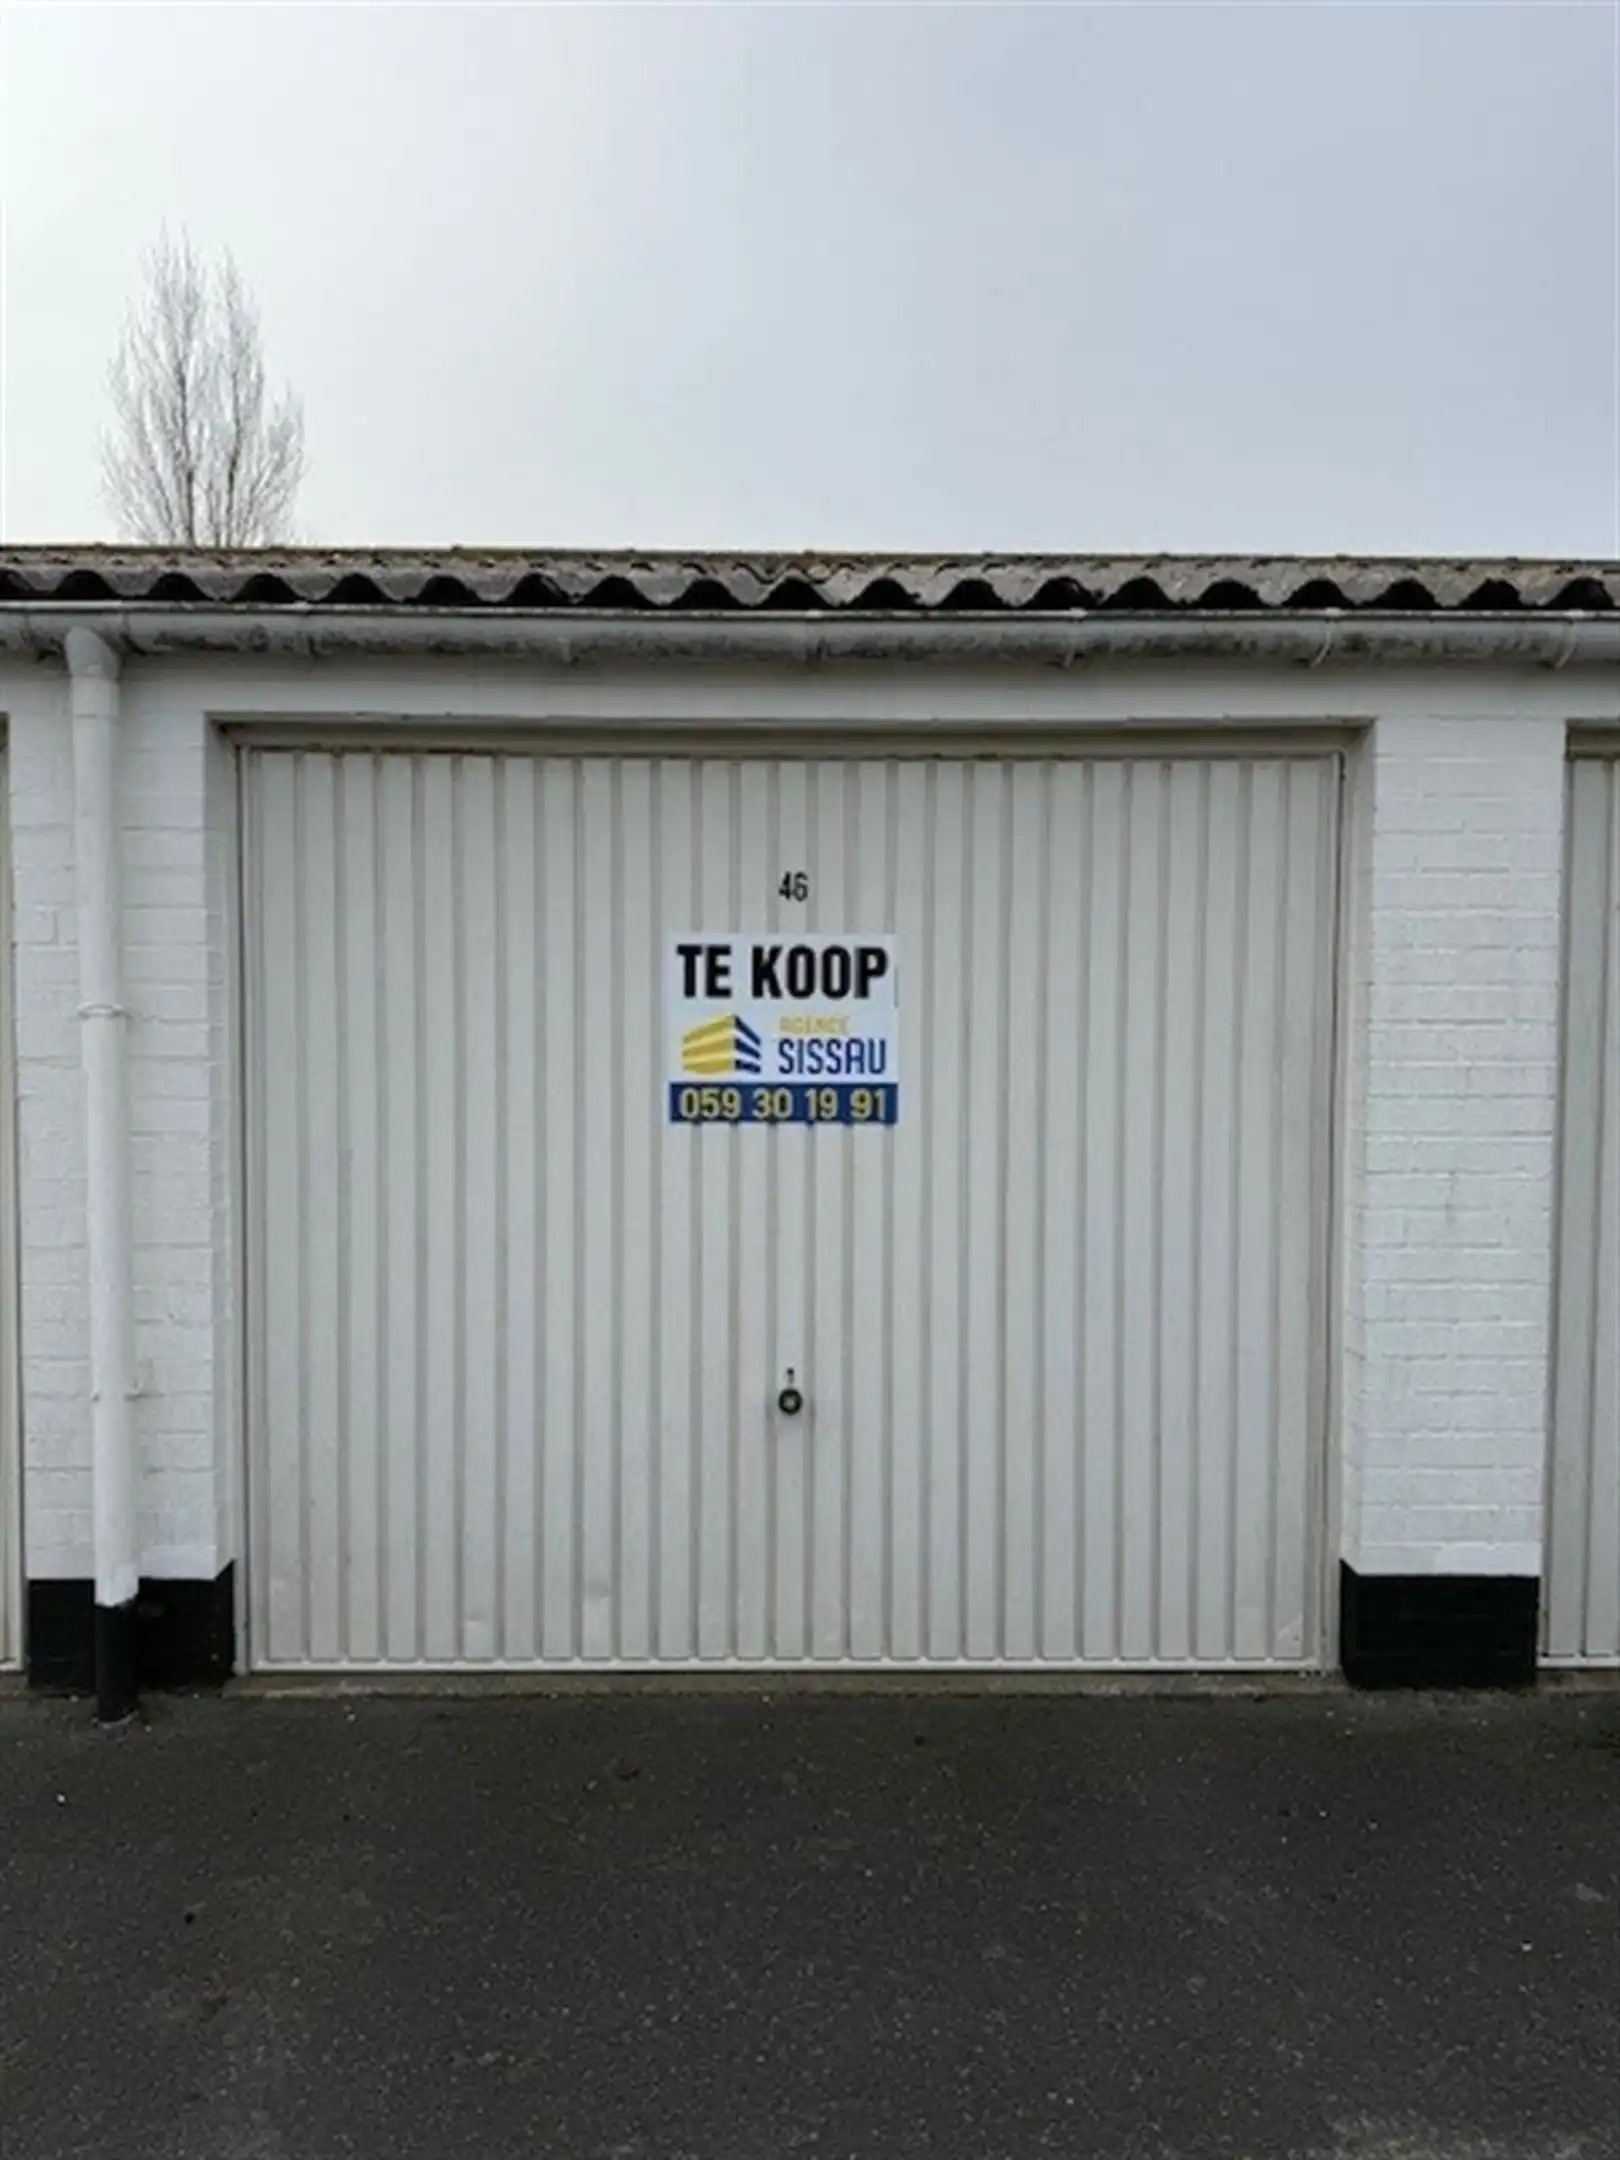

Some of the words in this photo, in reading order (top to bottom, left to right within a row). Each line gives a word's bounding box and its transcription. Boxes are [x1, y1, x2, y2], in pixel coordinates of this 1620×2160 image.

[778, 871, 809, 902] 46
[676, 944, 732, 999] TE
[751, 944, 888, 1000] KOOP
[777, 1038, 886, 1075] SISSAU
[680, 1088, 741, 1118] 059
[753, 1088, 793, 1118] 30
[804, 1088, 838, 1118] 19
[851, 1088, 886, 1118] 91
